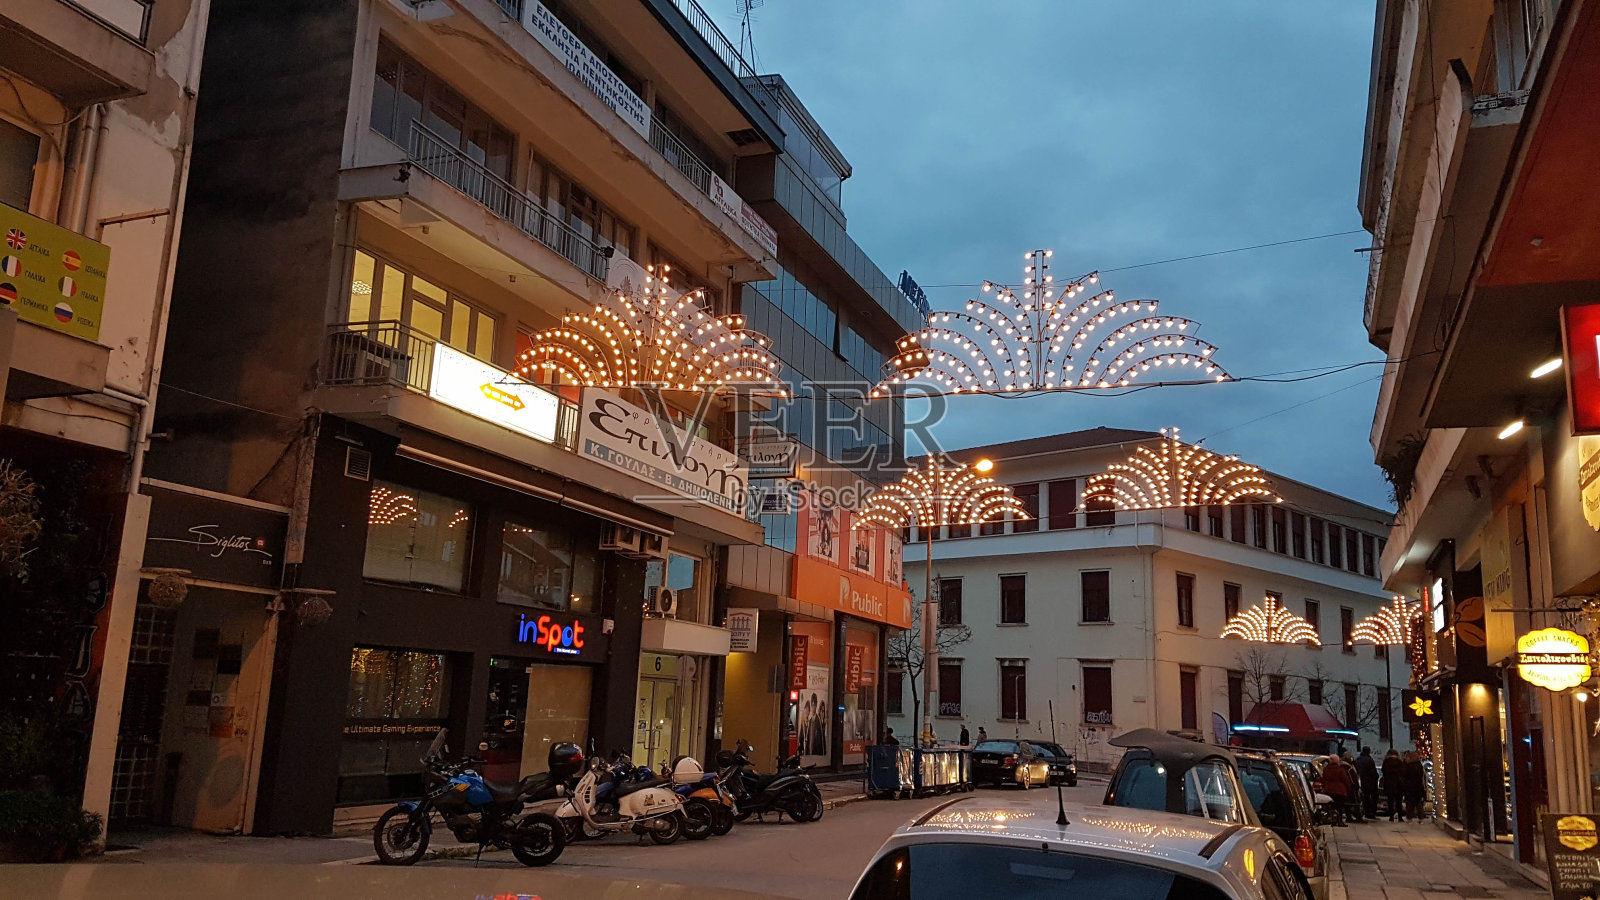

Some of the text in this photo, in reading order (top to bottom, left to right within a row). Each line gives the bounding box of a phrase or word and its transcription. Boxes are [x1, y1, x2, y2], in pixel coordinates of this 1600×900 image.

[531, 14, 645, 126] ΕΚΚΛΗΣΙΑ ΠΕΝΤΗΚΟΣΤΗΣ
[536, 4, 644, 112] ΕΛΕΥΘΕΡΑ ΑΠΟΣΤΟΛΙΚΗ
[565, 59, 617, 112] ΙΩΑΝΝΙΝΩΝ
[589, 398, 744, 515] Επιλογή
[608, 448, 656, 480] ΓΟΥΛΑΣ
[678, 479, 733, 510] ΔΗΜΟΛΕΝΗ
[187, 524, 259, 558] Siglitos
[851, 591, 883, 617] Public
[519, 613, 585, 652] inSpot
[655, 656, 661, 671] 6
[793, 637, 804, 686] Public
[850, 647, 861, 691] Public
[350, 724, 381, 734] Ultimate
[382, 725, 405, 735] Gaming
[849, 743, 862, 752] Public
